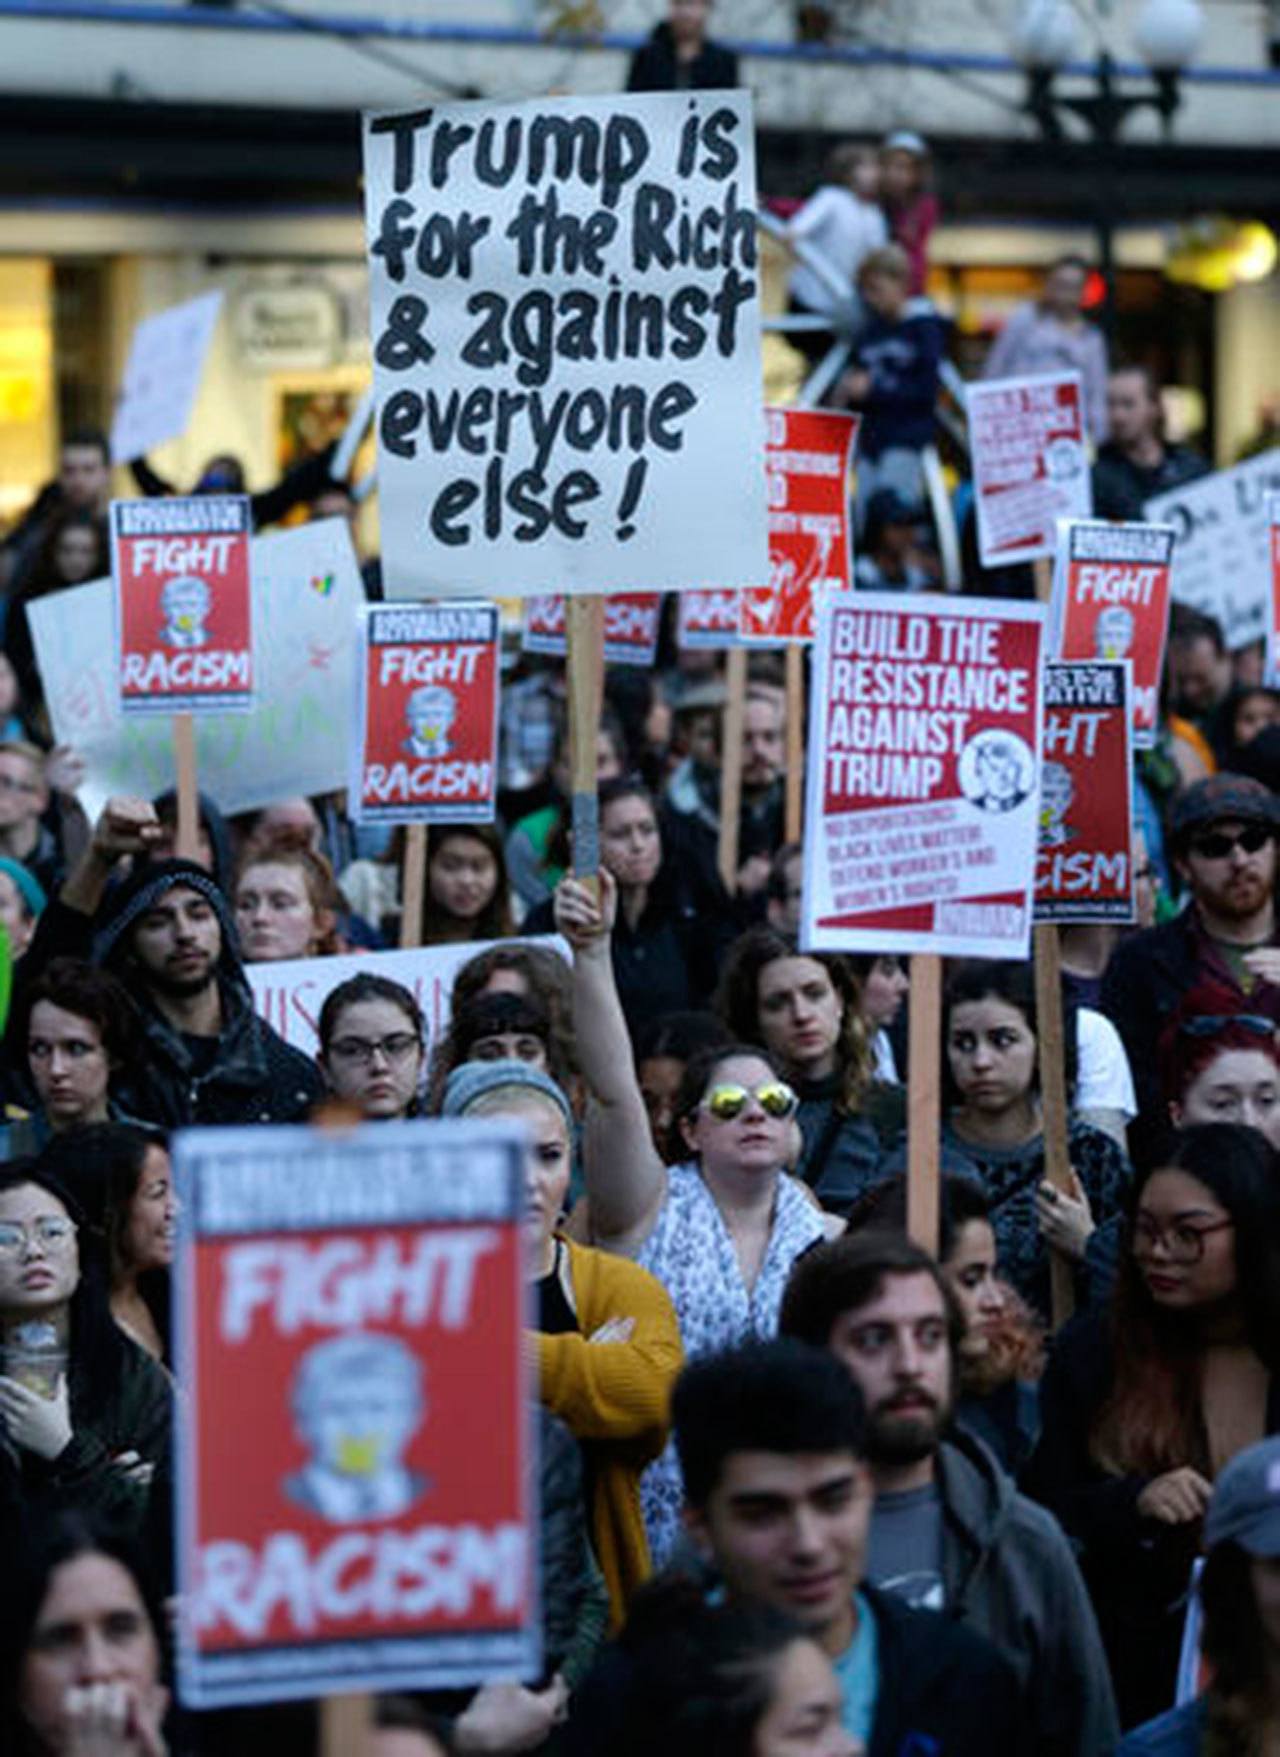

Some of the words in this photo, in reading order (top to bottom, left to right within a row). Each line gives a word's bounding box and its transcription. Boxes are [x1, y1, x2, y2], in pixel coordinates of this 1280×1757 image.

[370, 108, 650, 208] Trump
[677, 99, 741, 180] is
[372, 198, 491, 283] for
[507, 184, 618, 277] the
[633, 181, 758, 272] Rich
[374, 294, 435, 370] &
[460, 267, 756, 386] against
[380, 380, 699, 474] everyone
[132, 536, 238, 577] FIGHT
[1076, 564, 1164, 605] FIGHT
[835, 611, 929, 660] BUILD
[938, 618, 1000, 664] THE
[123, 650, 248, 690] RACISM
[380, 645, 487, 687] FIGHT
[831, 659, 1029, 713] RESISTANCE
[829, 706, 971, 754] AGAINST
[364, 760, 491, 800] RACISM
[827, 752, 943, 798] TRUMP
[221, 1226, 500, 1345] FIGHT
[196, 1522, 527, 1640] RACISM
